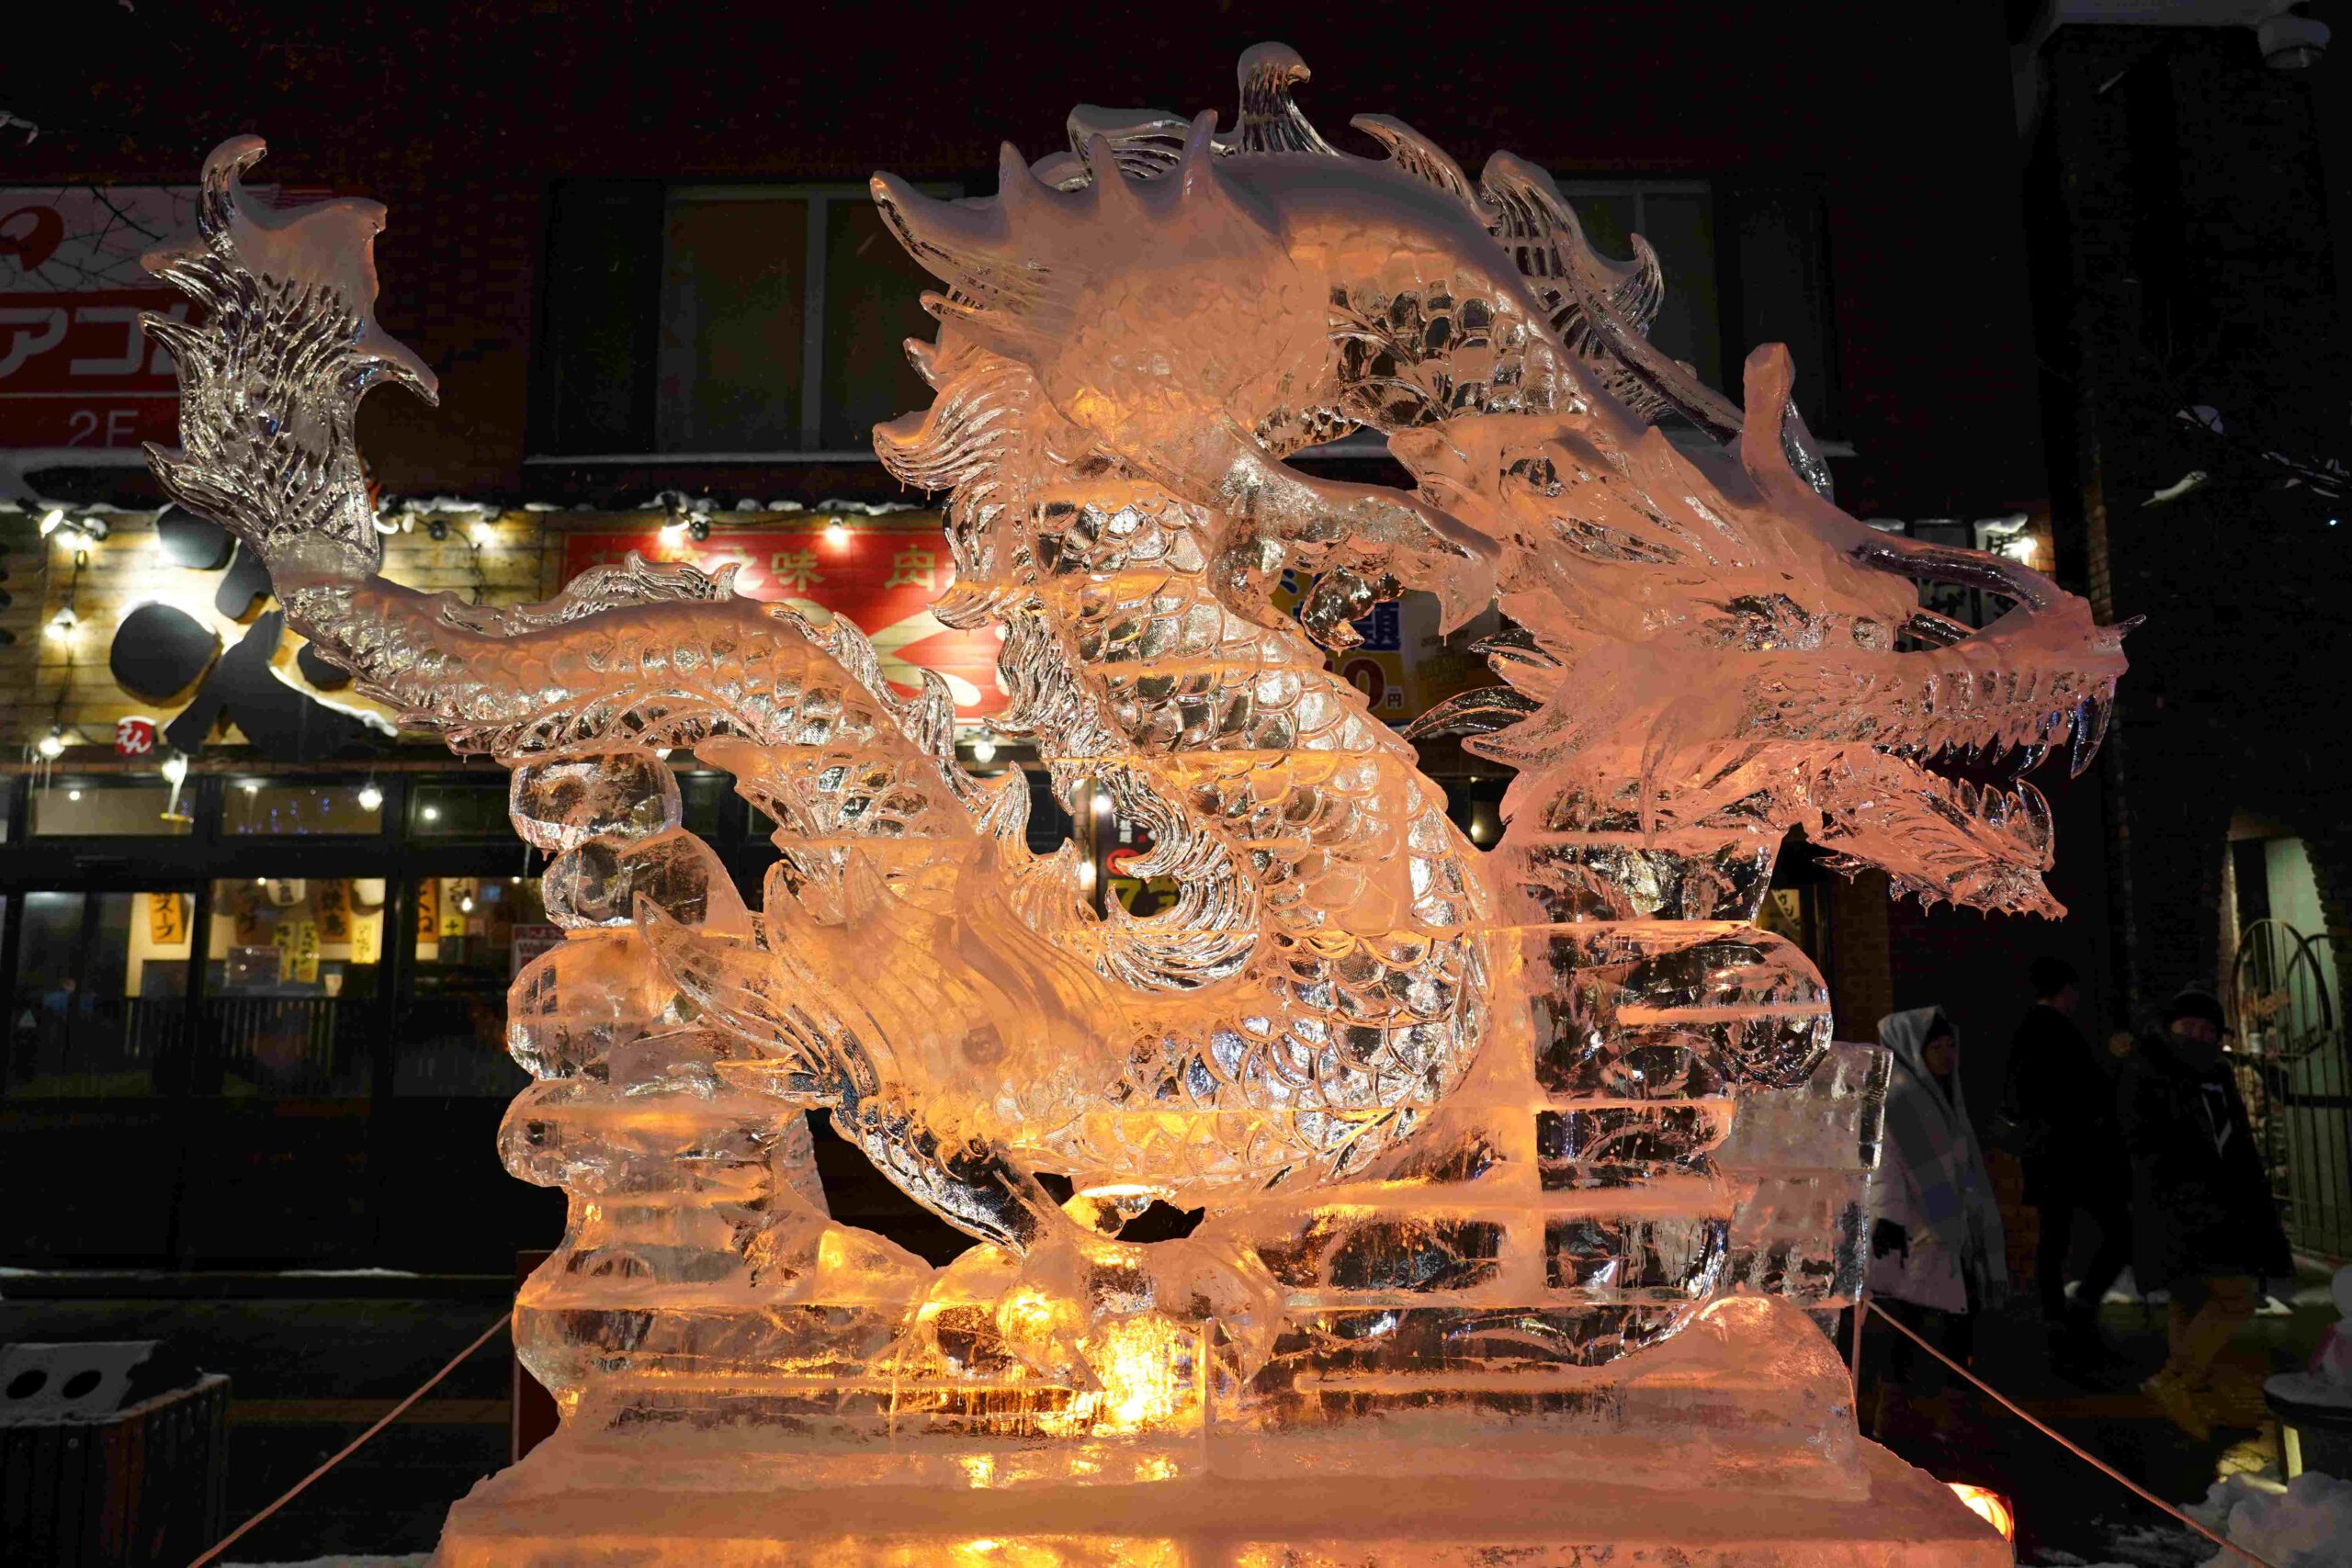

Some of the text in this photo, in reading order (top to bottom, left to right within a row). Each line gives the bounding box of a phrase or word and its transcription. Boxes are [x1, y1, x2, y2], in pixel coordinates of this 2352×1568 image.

[67, 408, 140, 447] 2F
[153, 893, 176, 939] スープ
